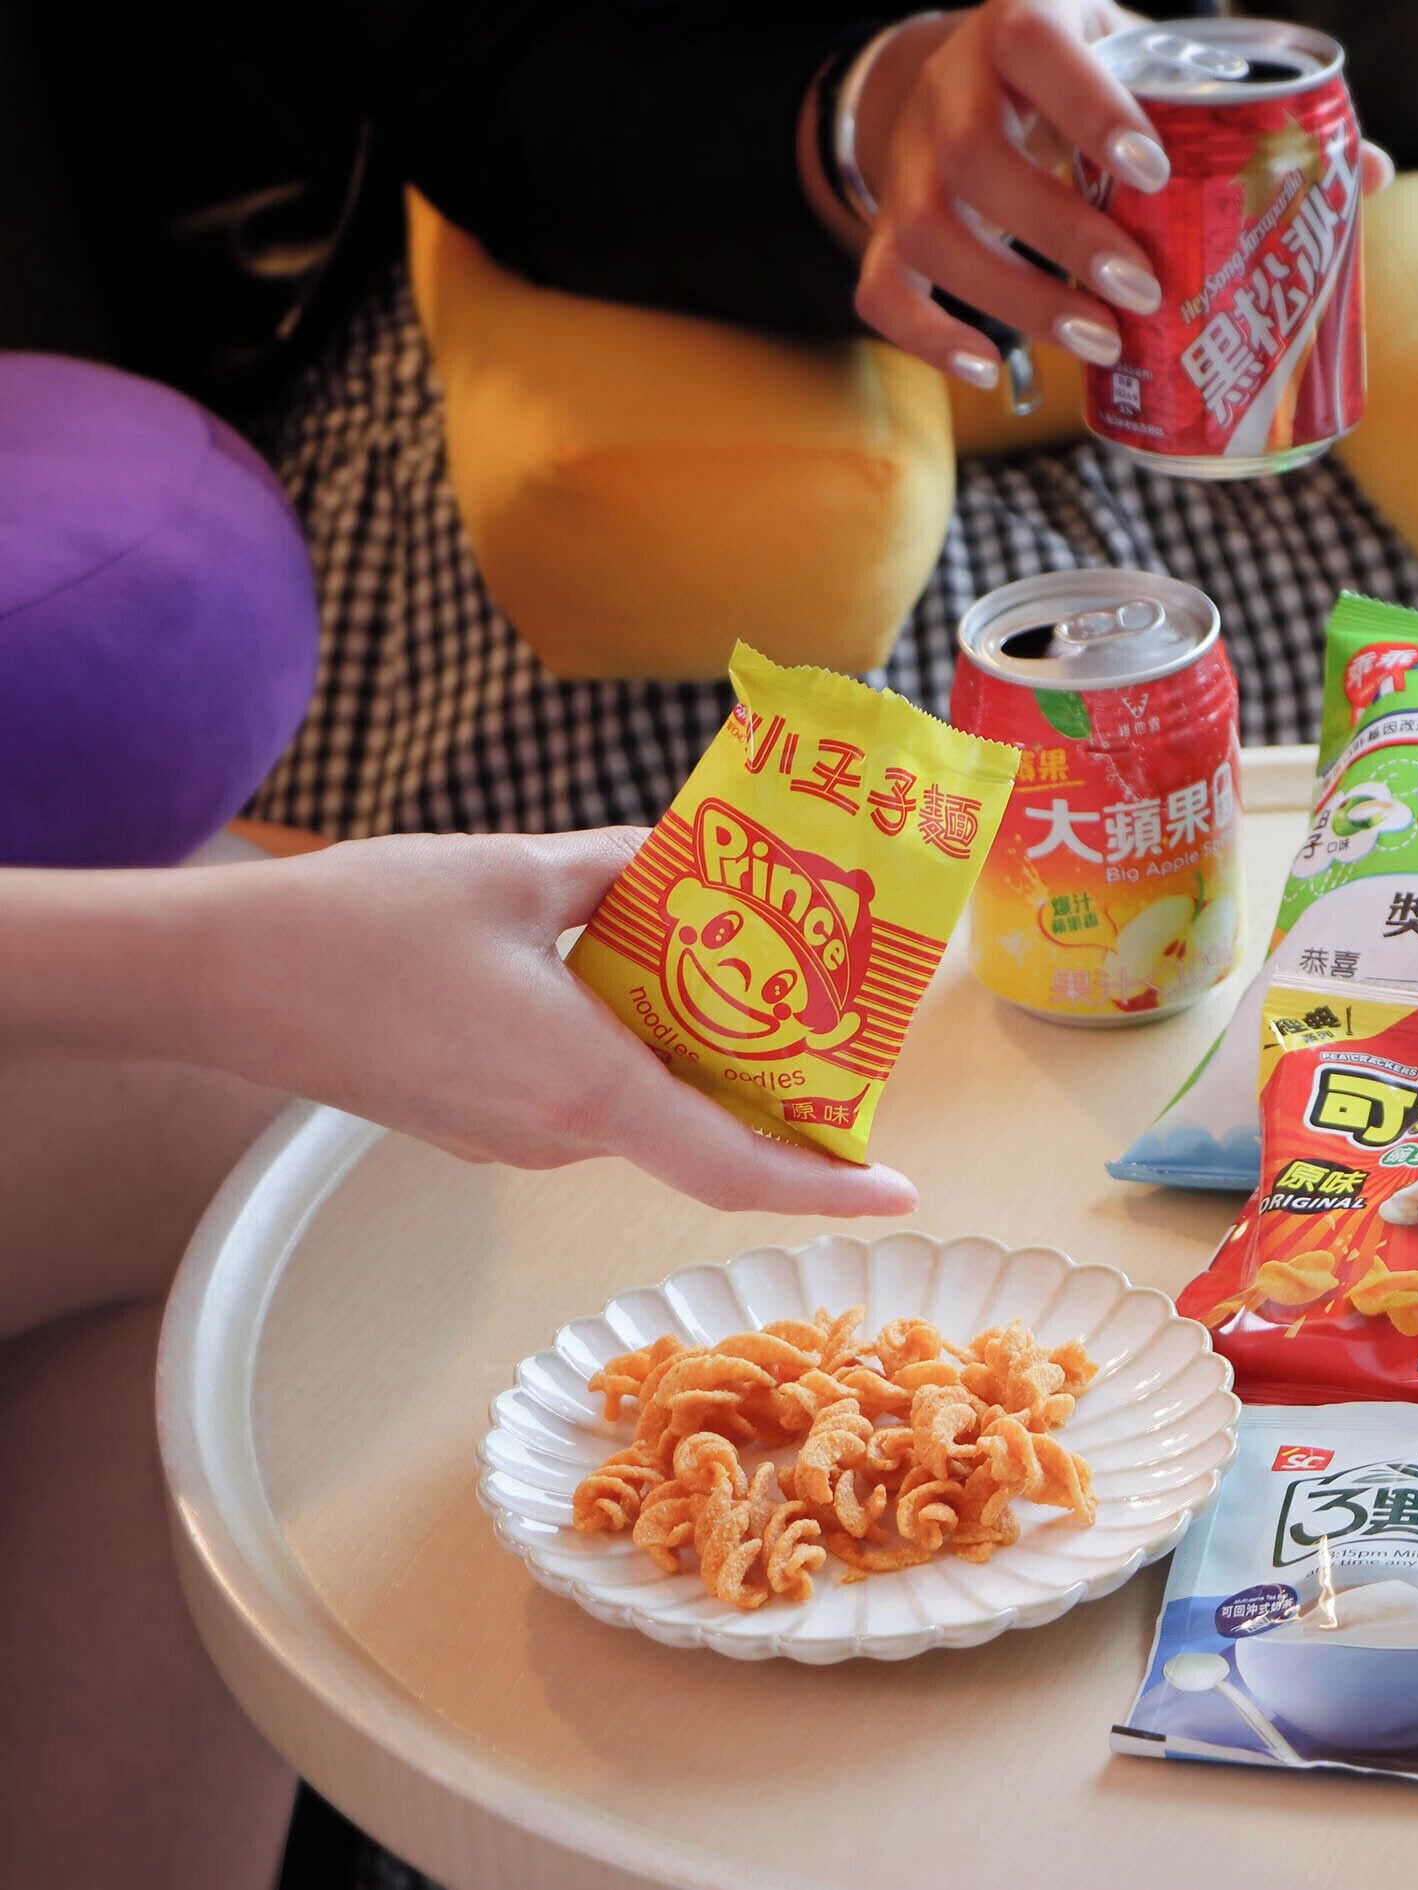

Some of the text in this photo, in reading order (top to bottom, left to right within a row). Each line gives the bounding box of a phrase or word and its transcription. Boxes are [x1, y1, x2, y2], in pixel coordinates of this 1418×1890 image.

[743, 711, 983, 860] 小王子麵
[1106, 866, 1140, 882] Big
[1146, 850, 1200, 878] Apple
[702, 808, 846, 972] Prince
[1299, 948, 1362, 979] 恭喜
[629, 984, 700, 1062] noodles
[1320, 1052, 1418, 1077] PEA CRACKERS
[791, 1102, 850, 1125] 原味
[1277, 1160, 1369, 1196] 原味
[1258, 1192, 1367, 1216] ORIGINAL
